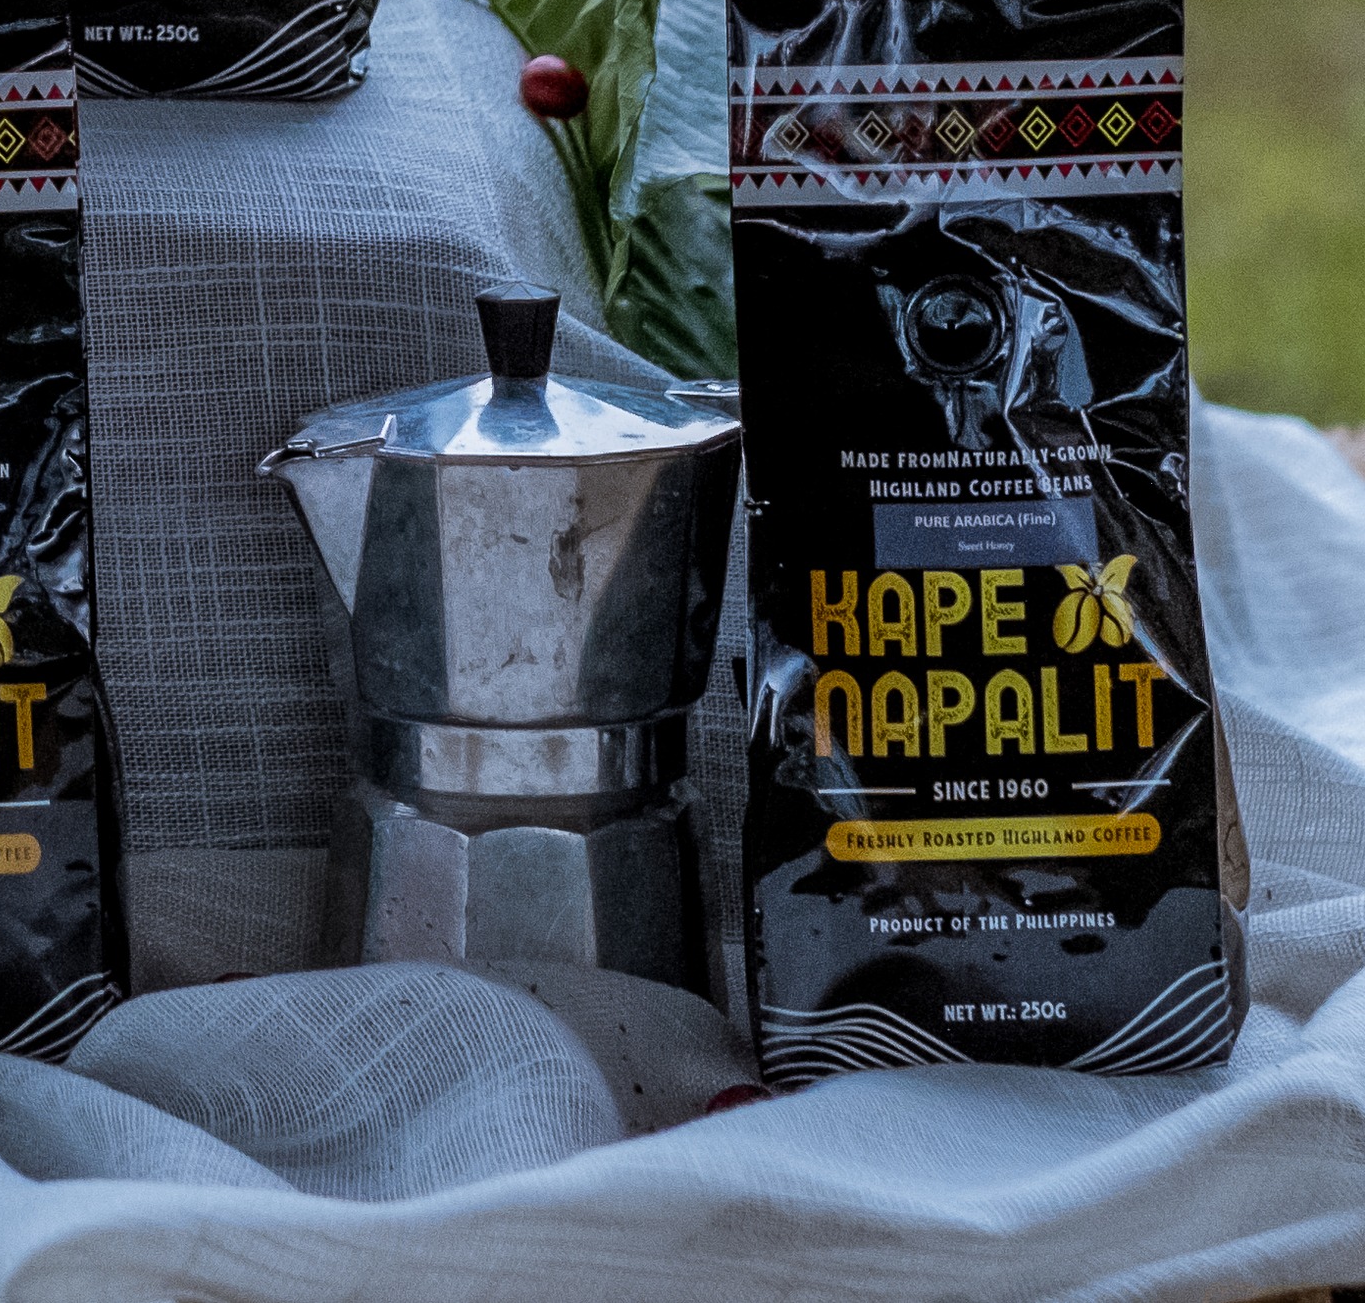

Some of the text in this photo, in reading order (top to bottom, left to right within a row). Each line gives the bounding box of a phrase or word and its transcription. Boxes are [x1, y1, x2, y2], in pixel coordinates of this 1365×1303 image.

[84, 26, 112, 41] NET
[156, 25, 200, 42] 250G
[841, 450, 890, 469] MADE
[870, 478, 961, 498] HIGHLAND
[969, 479, 1034, 496] COFFEE
[914, 512, 1057, 528] PURE ARABICA (Fine)
[810, 568, 1028, 657] KAPE
[814, 663, 1170, 757] NAPALIT
[933, 778, 1049, 802] SINCE 1960
[846, 827, 1151, 849] FRESHLY ROASTED HIGHLAND COFFEE
[870, 913, 1115, 933] PRODUCT OF THE PHILIPPINES
[944, 1005, 975, 1022] NET
[1021, 1001, 1067, 1020] 250G
